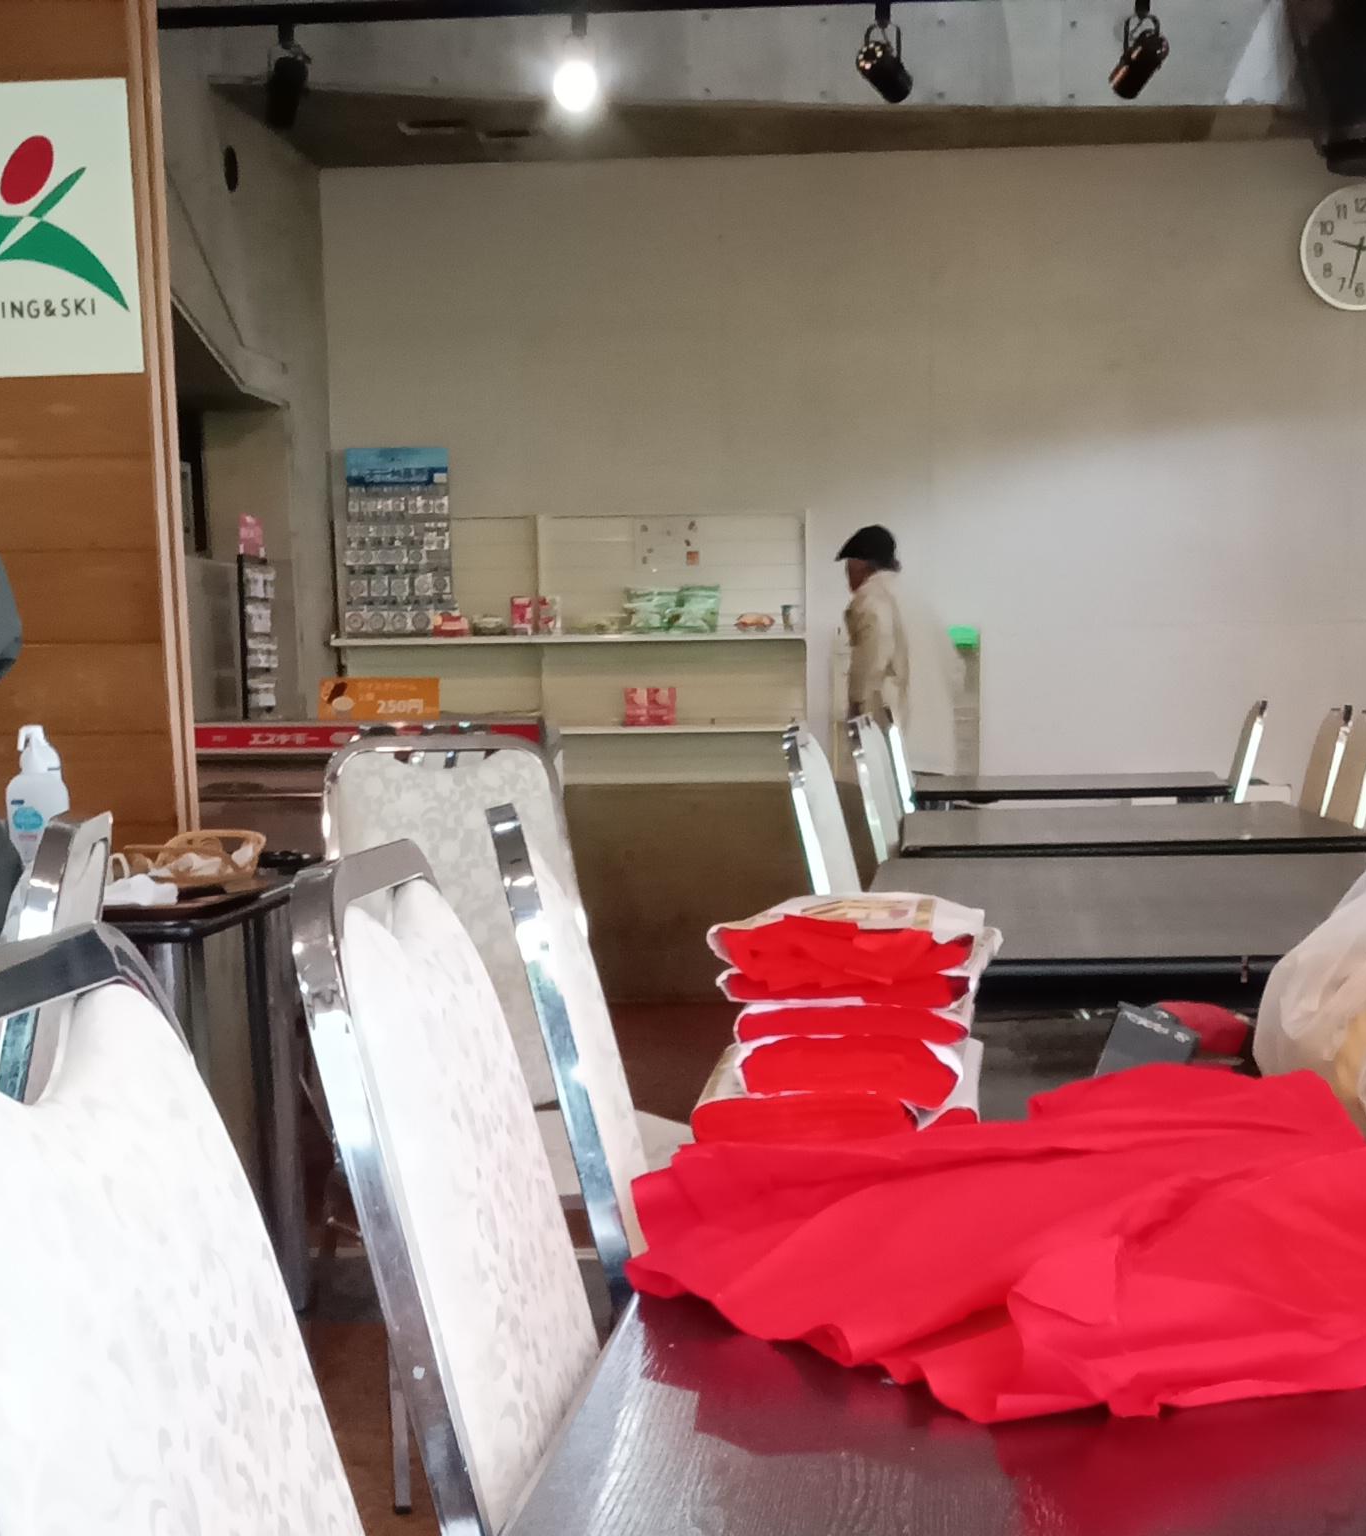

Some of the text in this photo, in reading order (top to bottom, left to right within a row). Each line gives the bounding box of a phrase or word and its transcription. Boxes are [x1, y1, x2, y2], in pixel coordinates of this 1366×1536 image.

[1336, 203, 1348, 220] 11
[1319, 220, 1335, 236] 10
[1313, 241, 1324, 258] 9
[1322, 262, 1333, 278] 8
[1337, 276, 1347, 293] 7
[1354, 282, 1365, 299] 6
